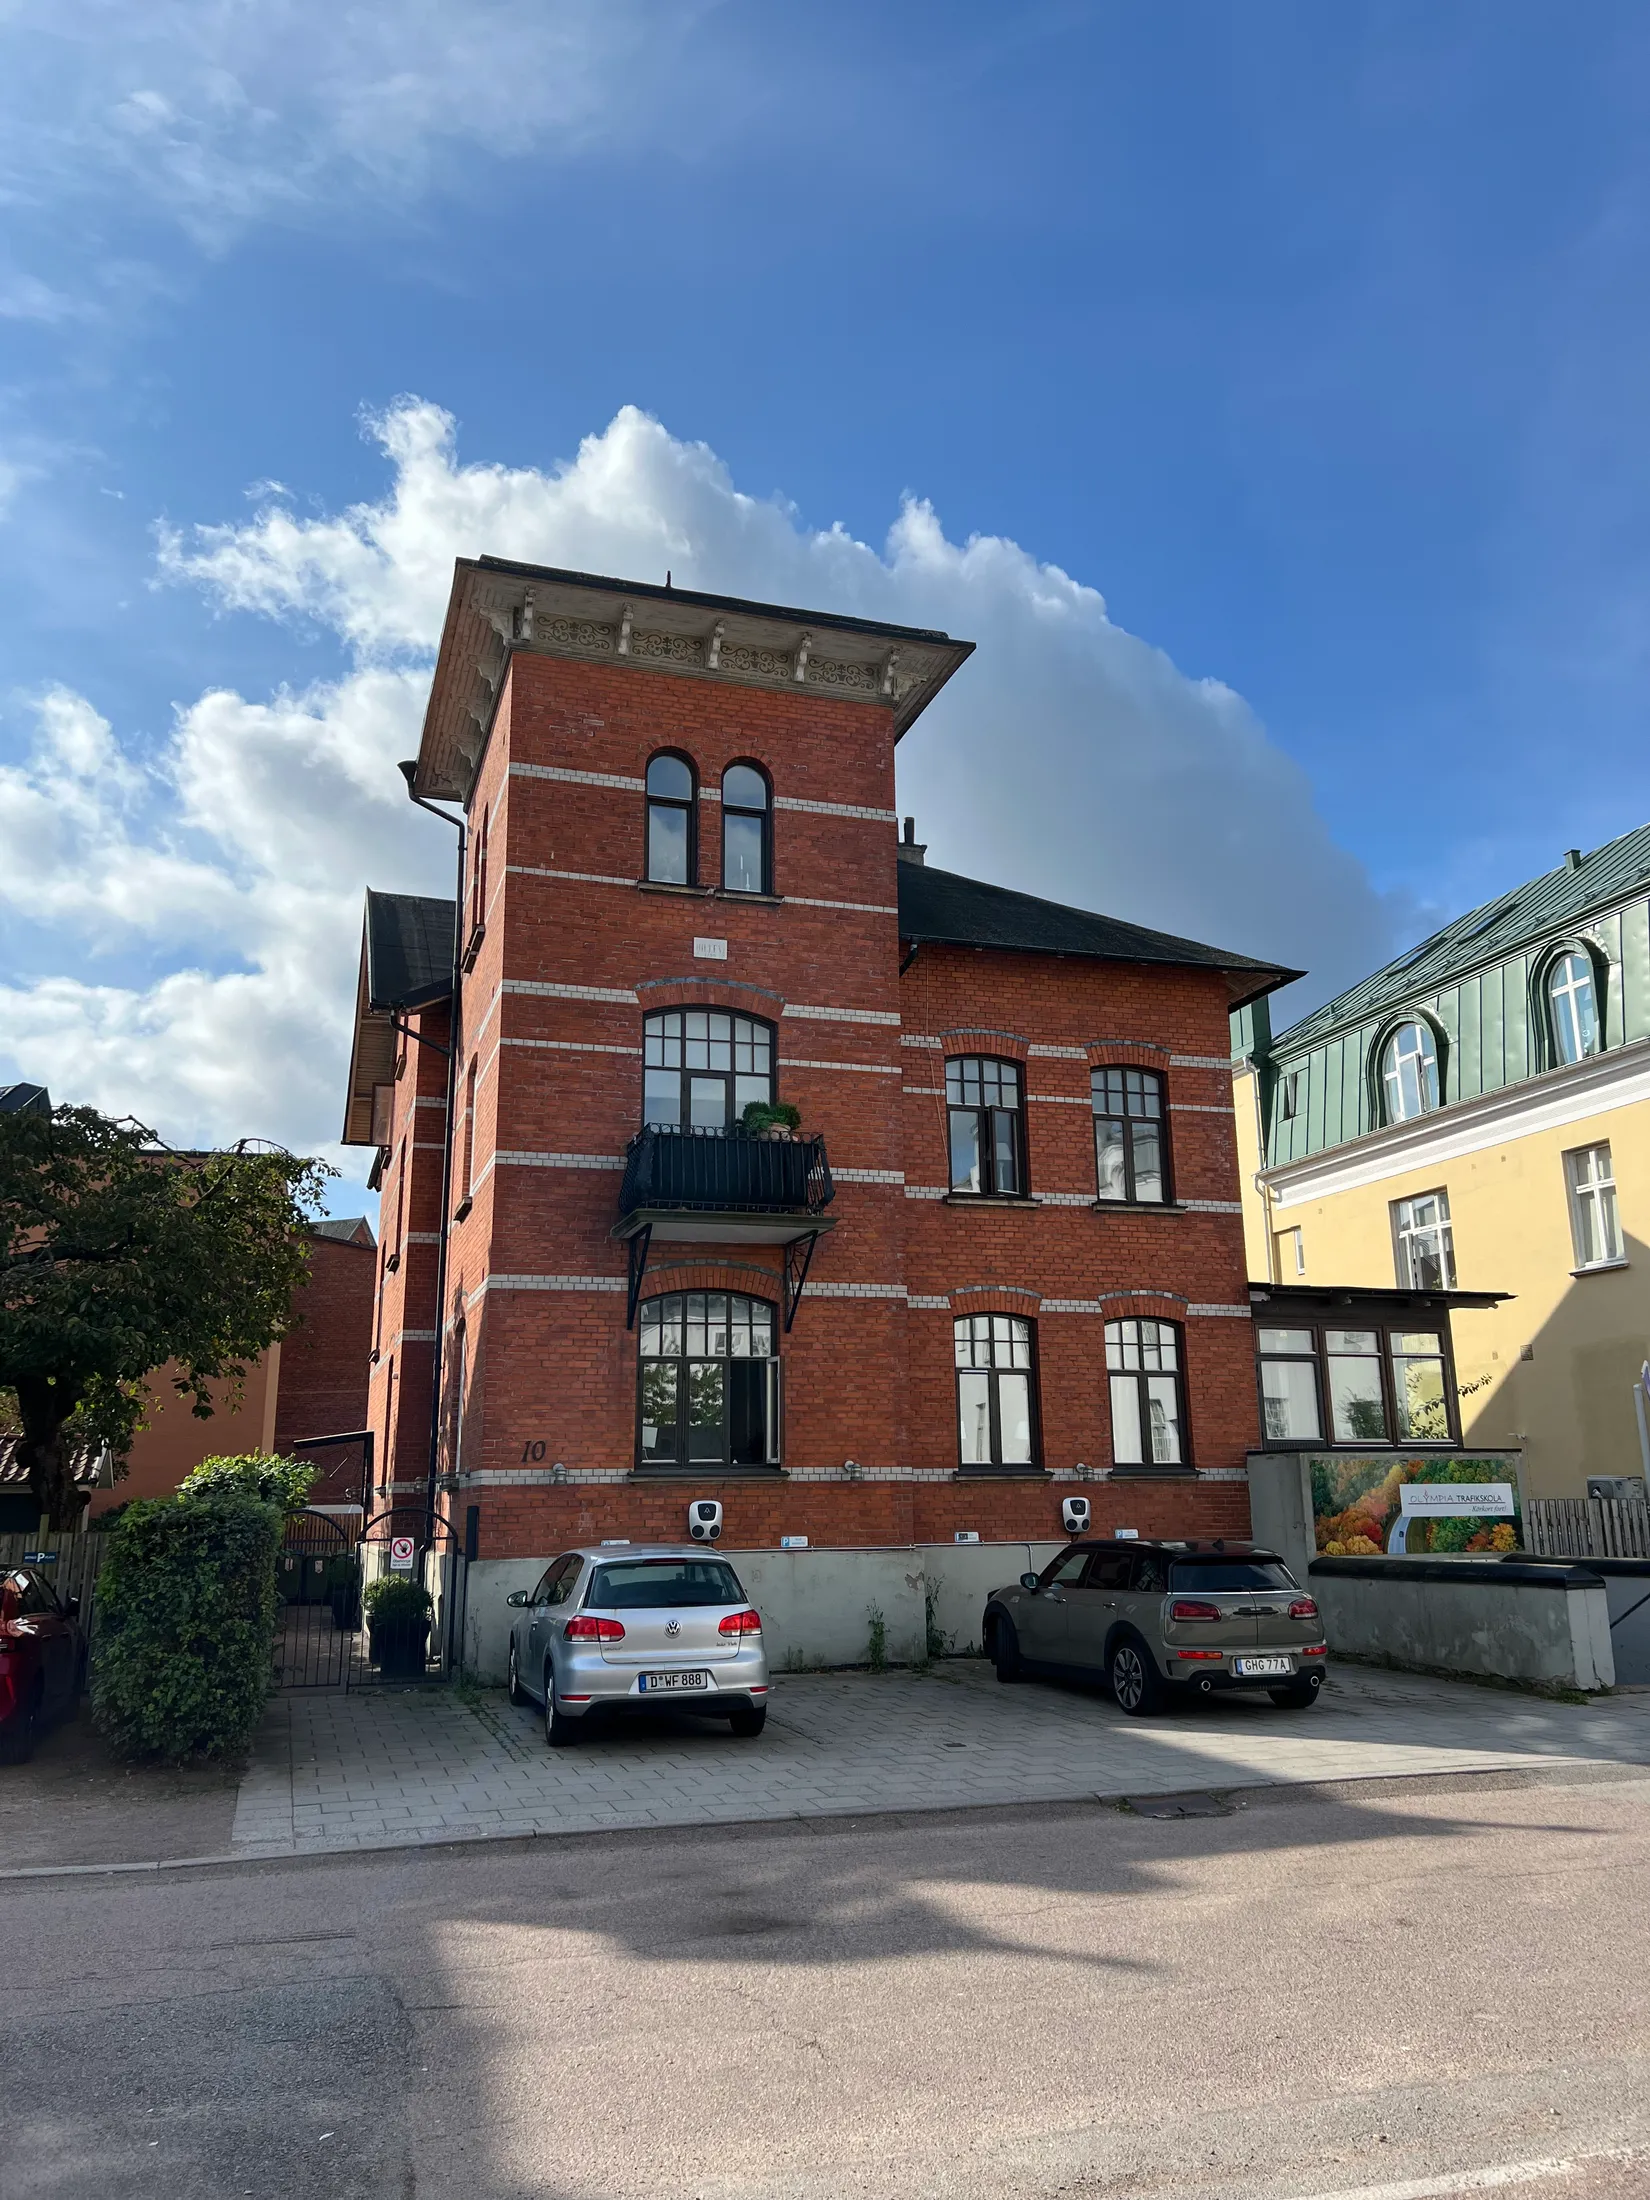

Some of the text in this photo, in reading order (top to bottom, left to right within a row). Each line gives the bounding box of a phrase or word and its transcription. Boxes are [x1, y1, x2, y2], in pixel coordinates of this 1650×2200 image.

[521, 1440, 546, 1462] 10
[1410, 1493, 1502, 1503] OLYMPIA TRAFIKSKOLA
[36, 1552, 46, 1563] P
[1245, 1659, 1286, 1671] GHG 77A
[664, 1675, 680, 1687] WF
[681, 1673, 702, 1686] 888
